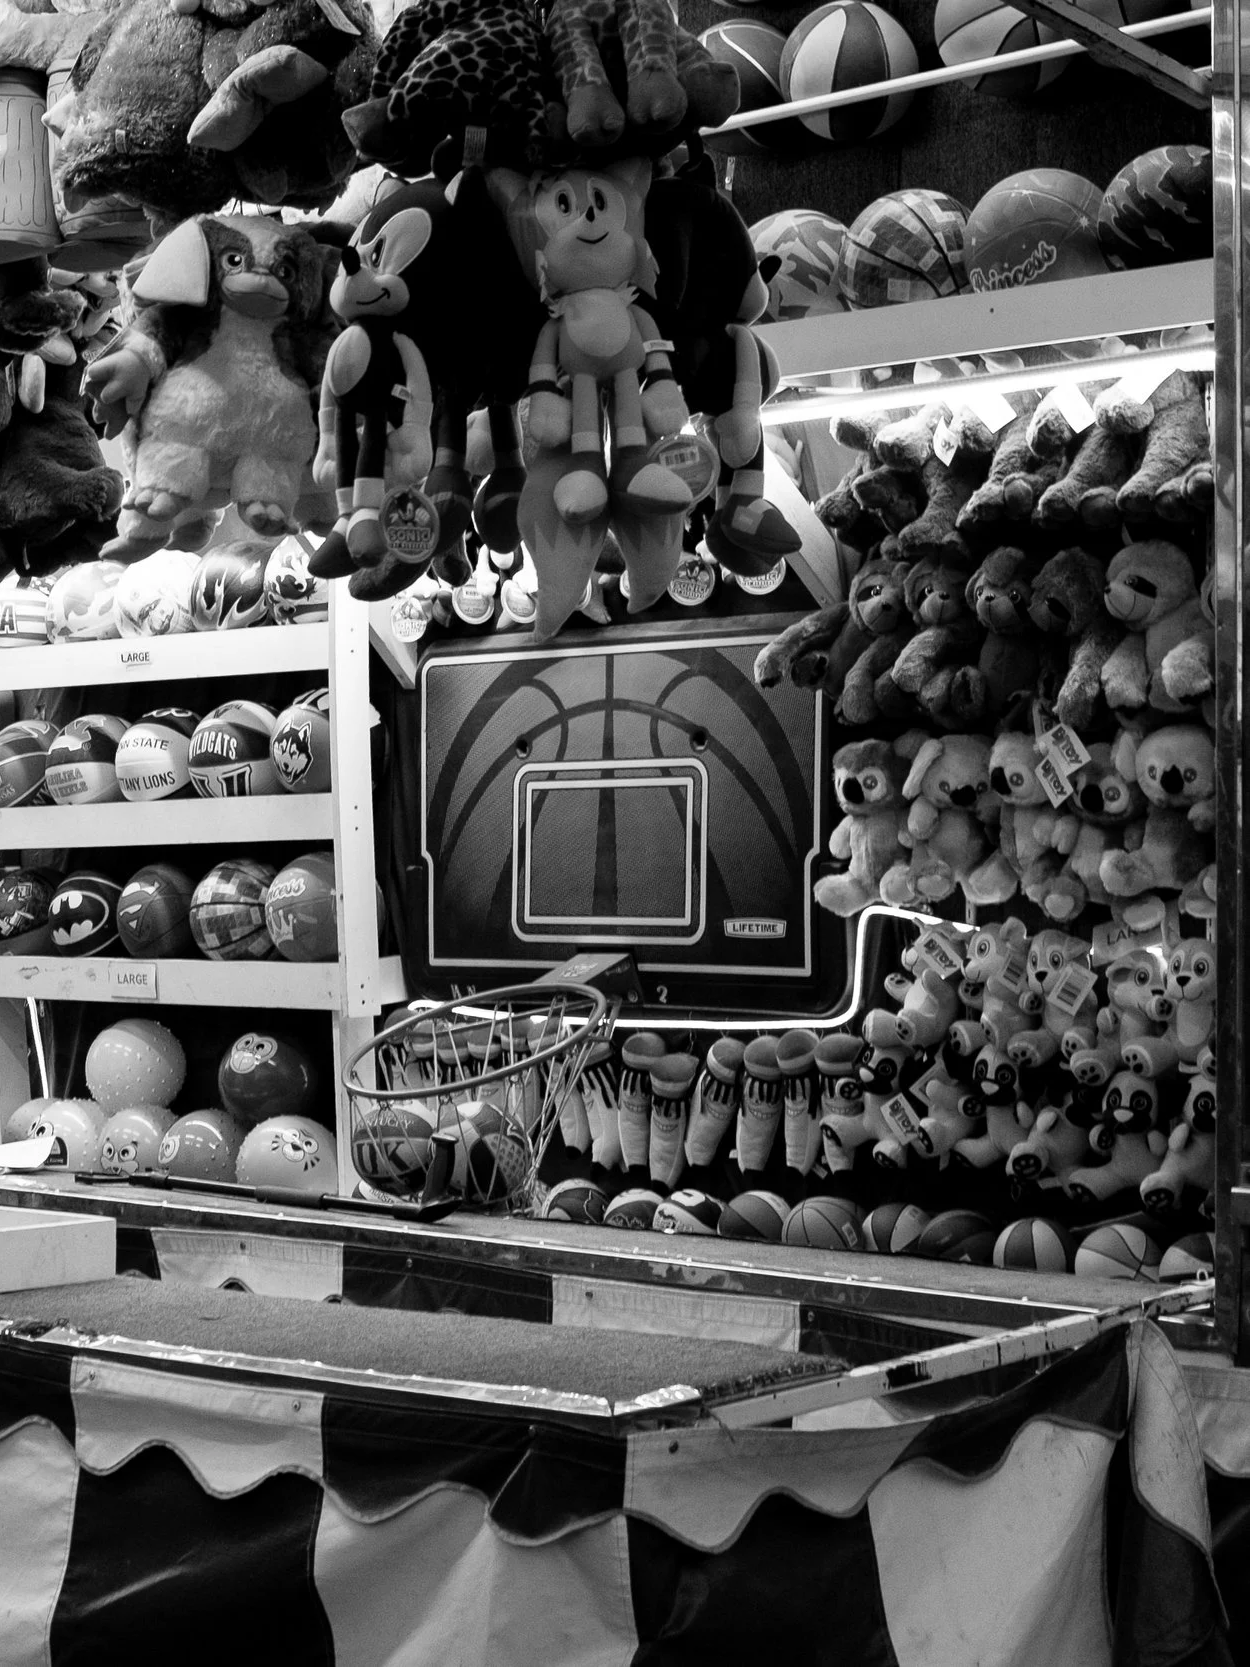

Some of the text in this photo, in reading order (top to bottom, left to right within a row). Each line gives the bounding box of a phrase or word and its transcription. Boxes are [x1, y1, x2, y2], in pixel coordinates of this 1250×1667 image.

[388, 526, 431, 542] SONIC
[120, 652, 150, 664] LARGE
[132, 737, 170, 751] STATE
[144, 772, 176, 790] LIONS
[732, 923, 779, 933] LIFETIME
[117, 974, 148, 985] LARGE
[657, 985, 669, 1004] 2
[356, 1143, 411, 1176] UK
